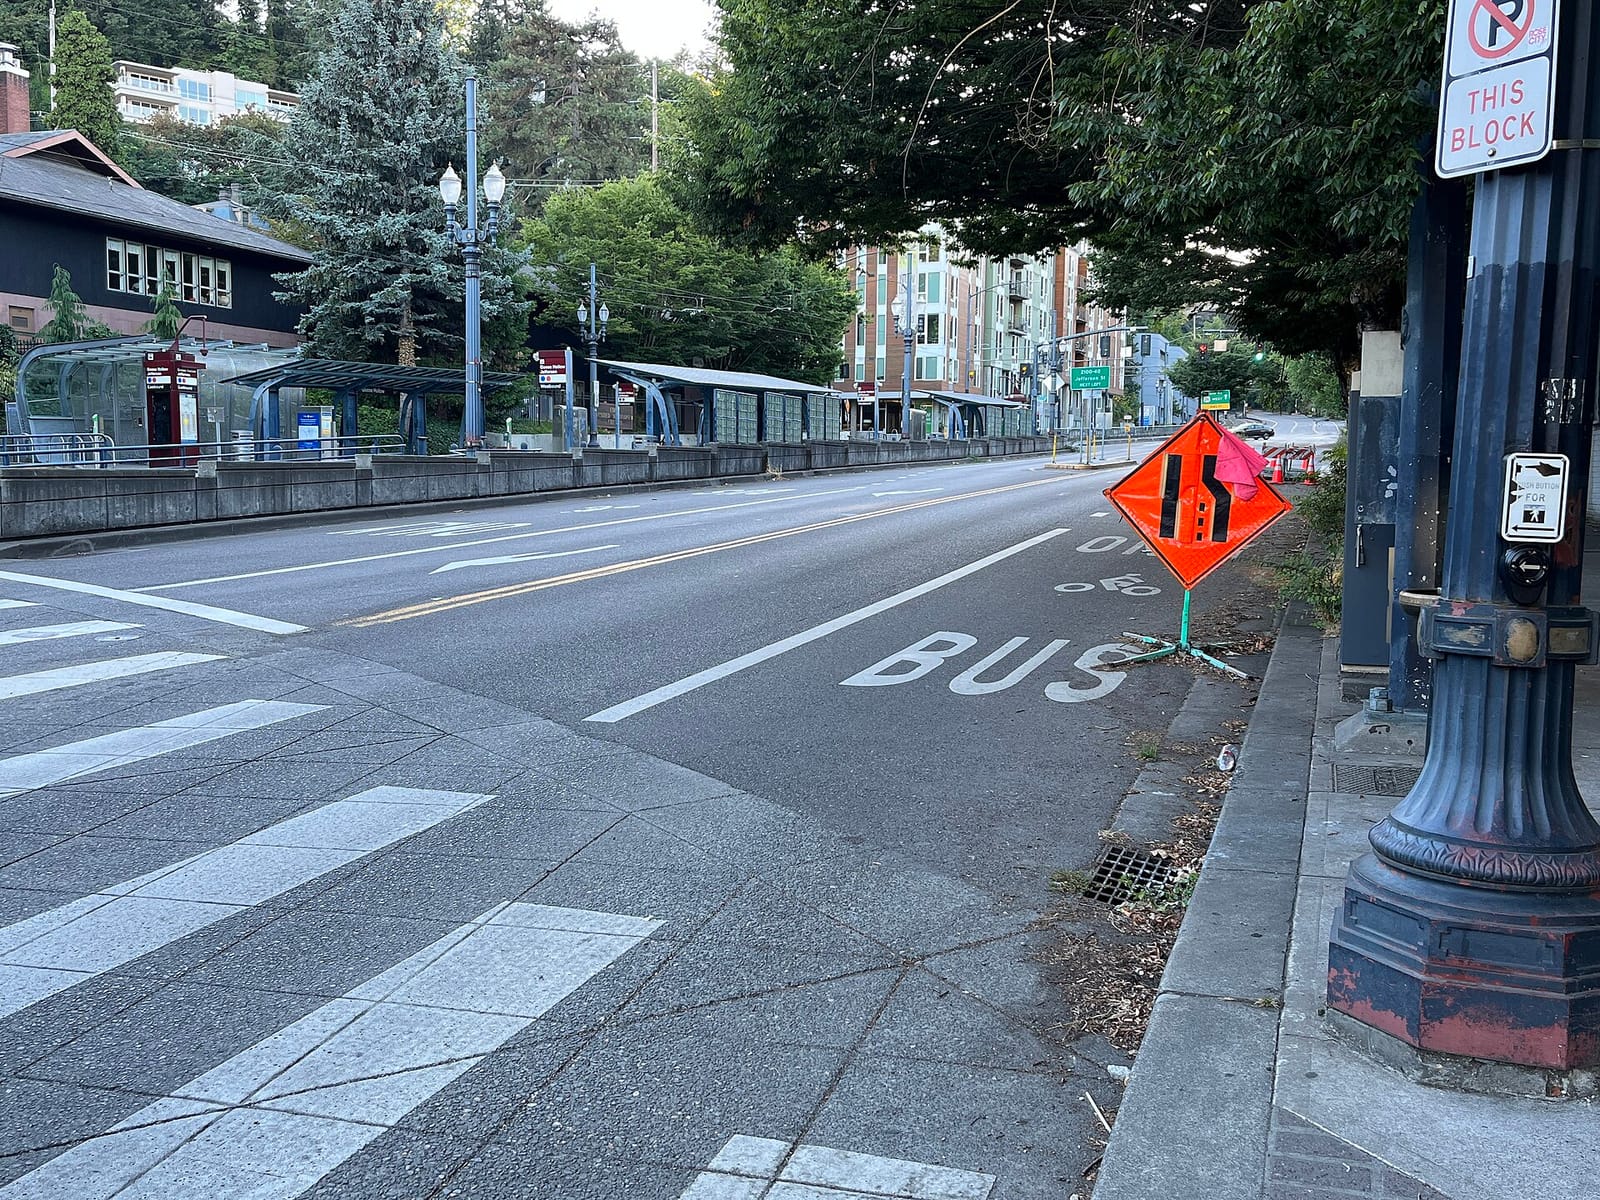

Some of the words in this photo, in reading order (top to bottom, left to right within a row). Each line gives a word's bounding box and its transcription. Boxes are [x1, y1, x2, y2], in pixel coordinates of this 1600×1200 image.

[1468, 79, 1524, 114] THIS
[1451, 110, 1536, 152] BLOCK
[1525, 493, 1546, 502] FOR
[1536, 481, 1560, 490] BUTTON
[838, 631, 1143, 703] BUS
